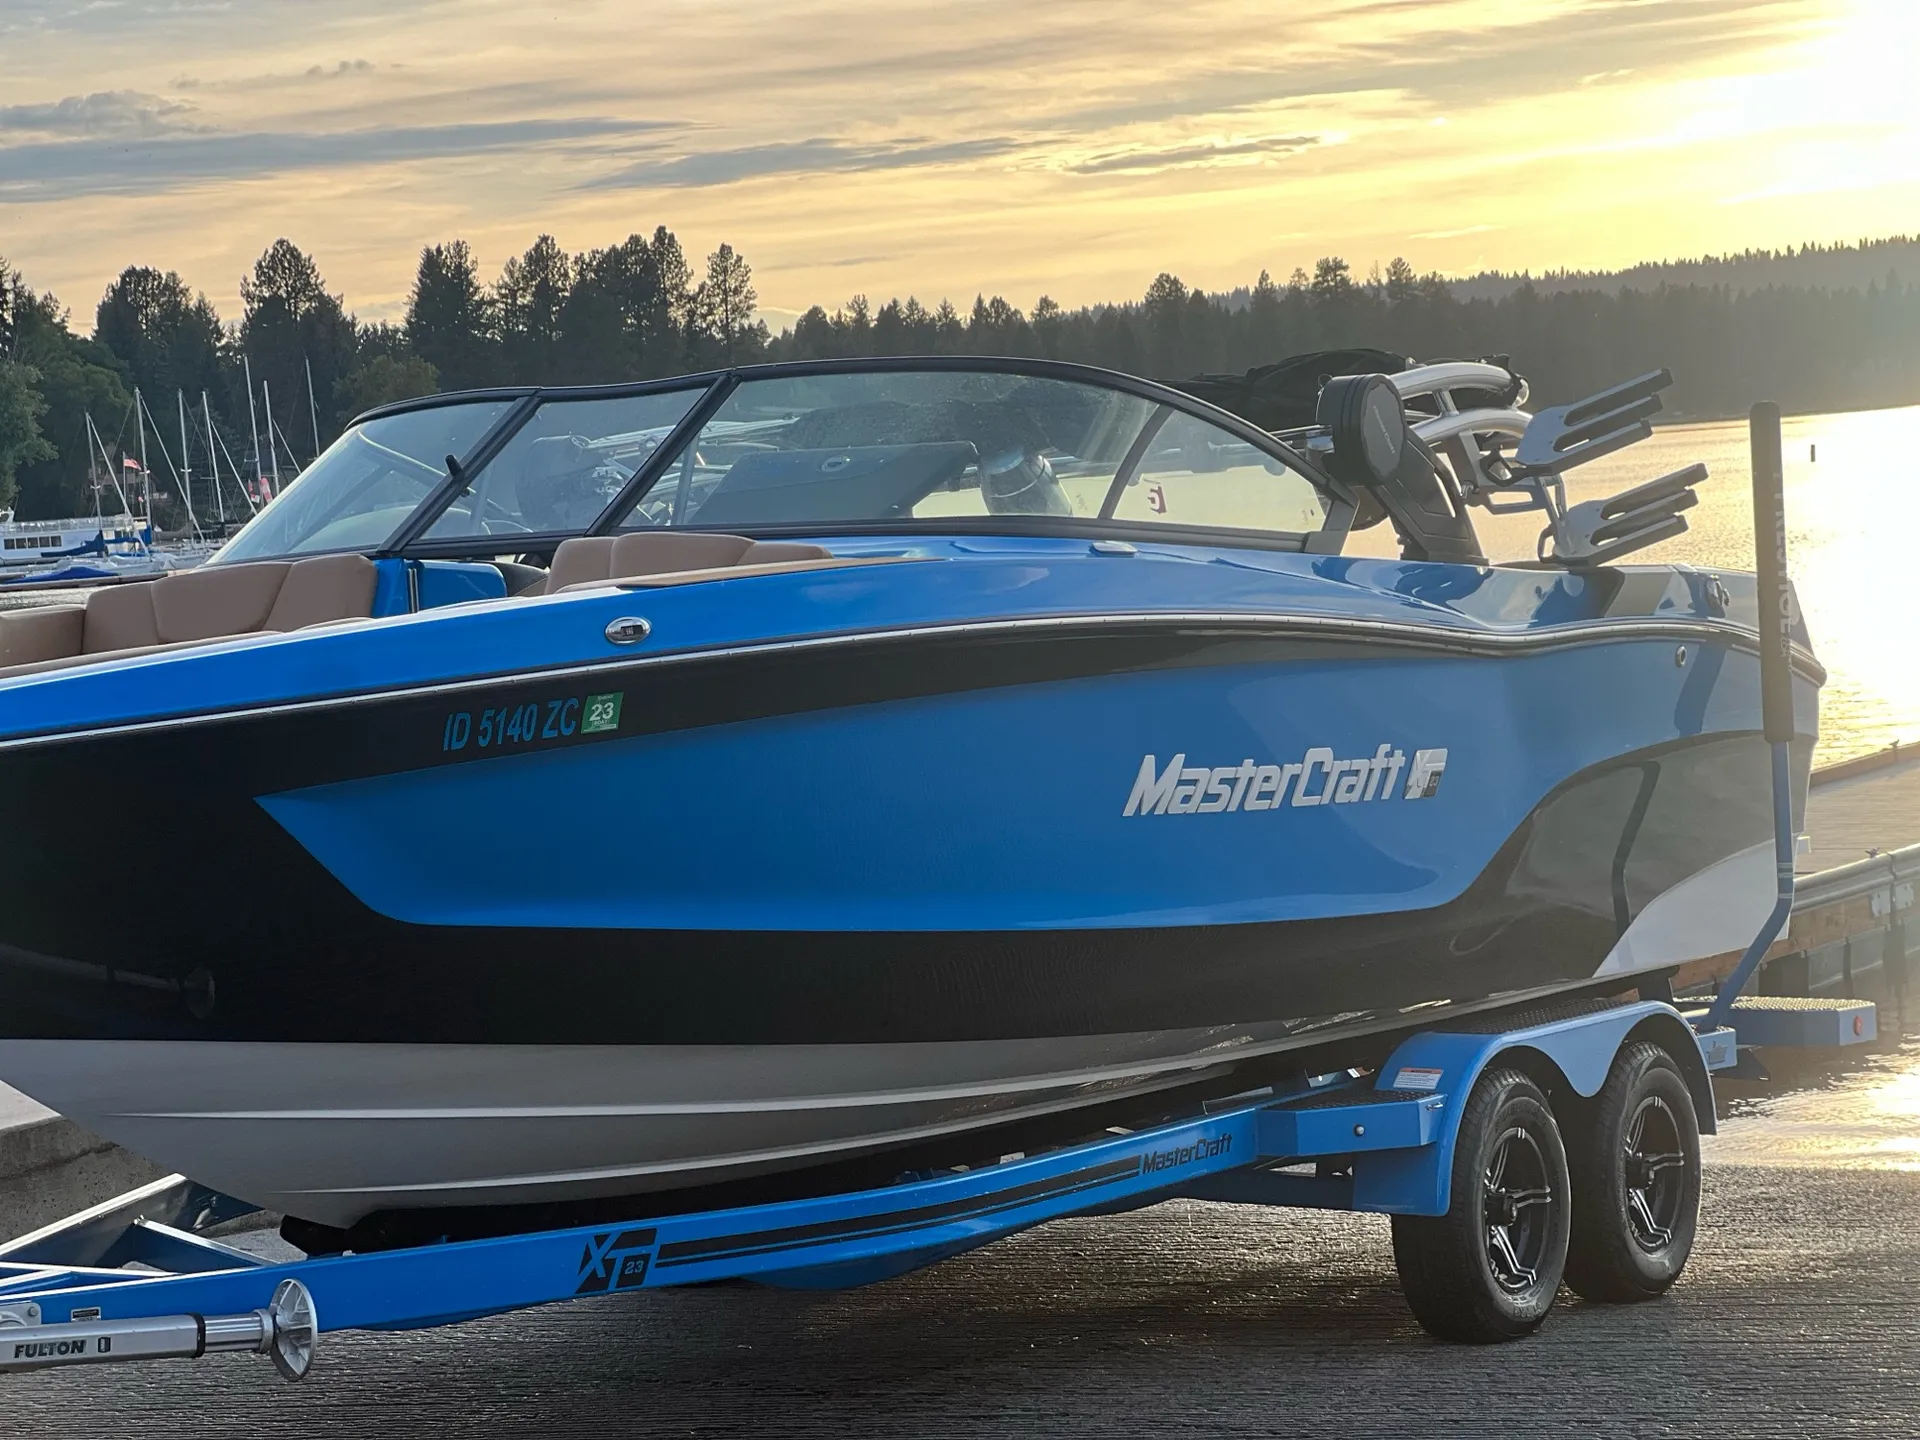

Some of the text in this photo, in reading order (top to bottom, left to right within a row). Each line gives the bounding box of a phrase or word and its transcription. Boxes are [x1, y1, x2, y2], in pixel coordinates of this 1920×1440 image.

[589, 702, 614, 721] 23
[443, 697, 580, 751] ID 5140 ZC
[1122, 743, 1406, 817] MasterCraft
[1428, 775, 1440, 788] 23
[1142, 1132, 1232, 1174] MasterCraft
[624, 1260, 645, 1275] 23
[14, 1339, 86, 1359] FULTON
